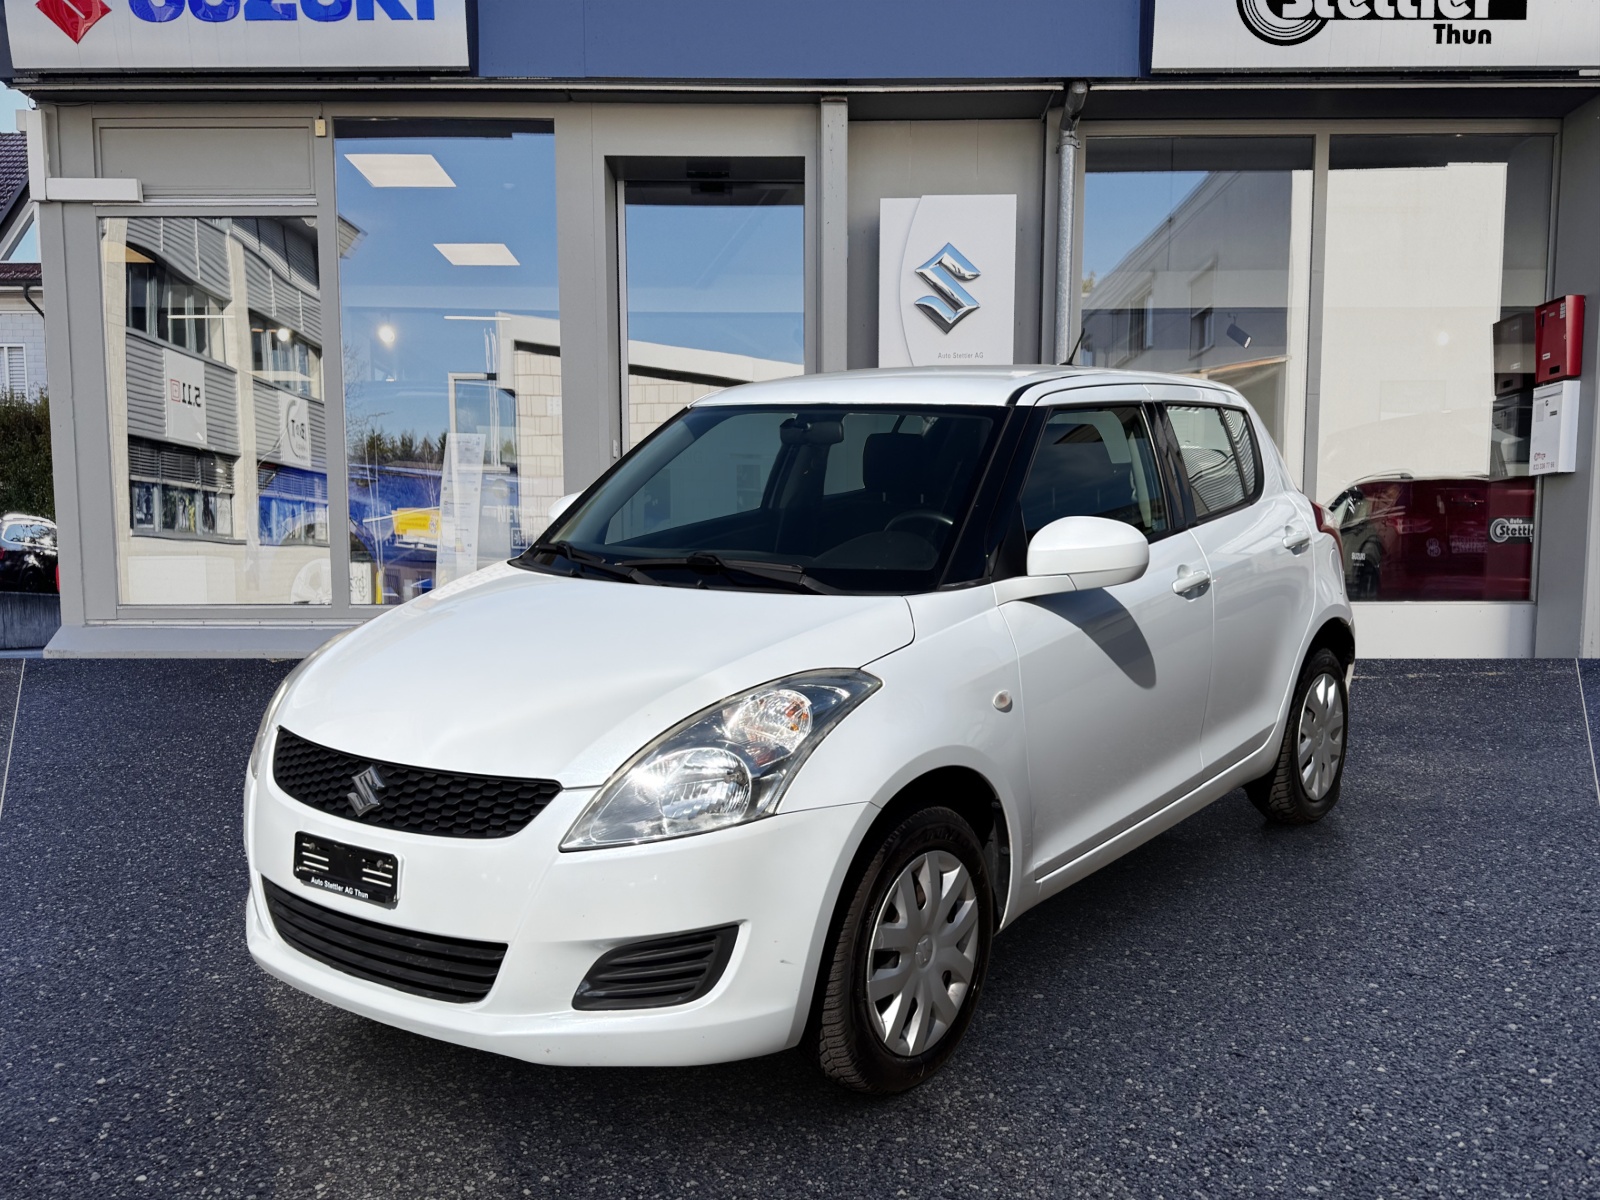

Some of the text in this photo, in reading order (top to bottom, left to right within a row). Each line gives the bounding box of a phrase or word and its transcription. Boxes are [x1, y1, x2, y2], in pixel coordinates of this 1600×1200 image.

[1433, 23, 1492, 45] Thun
[974, 351, 984, 359] AG
[311, 876, 369, 899] Auto Stettler AG Thun
